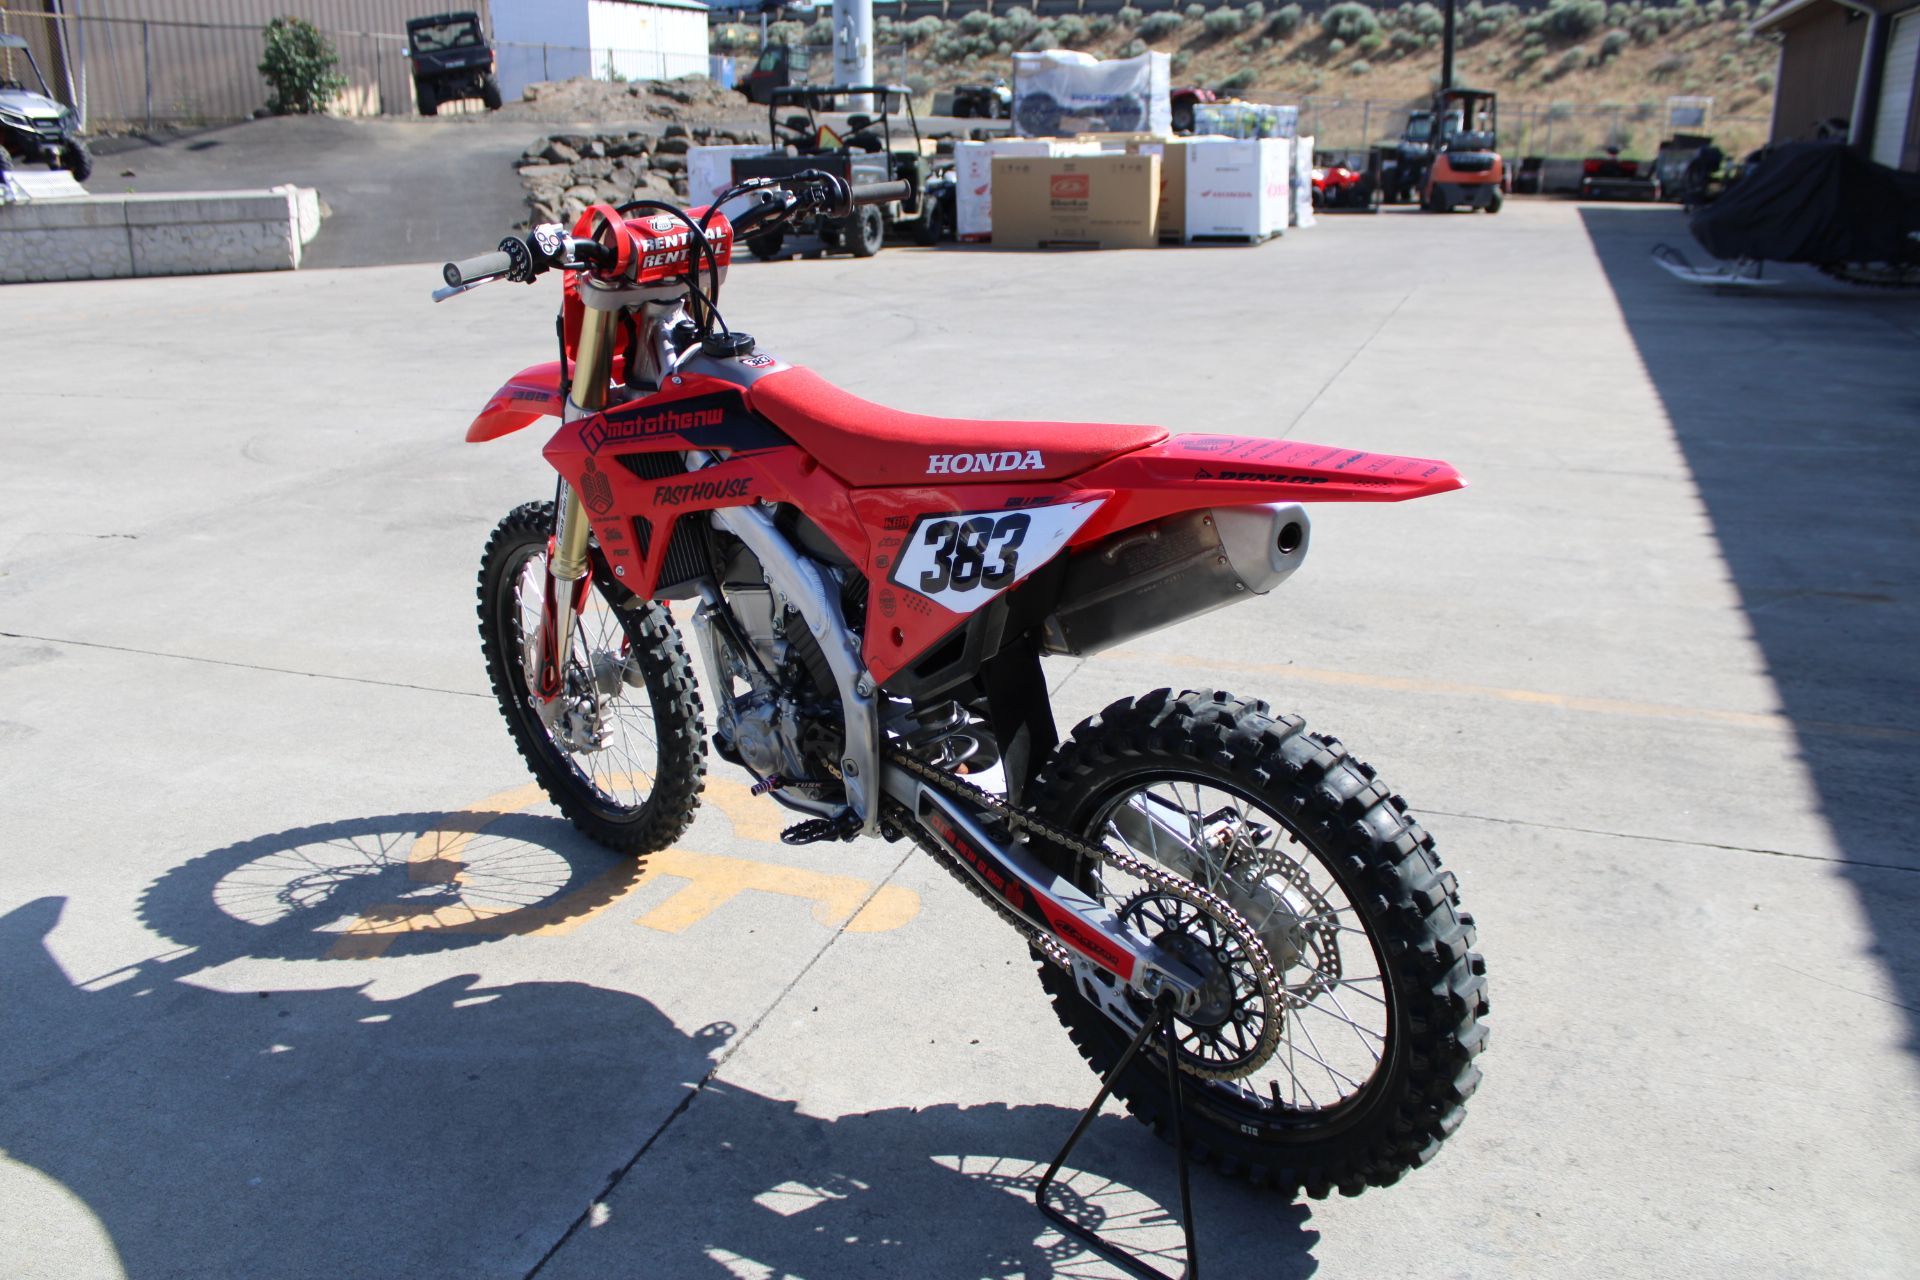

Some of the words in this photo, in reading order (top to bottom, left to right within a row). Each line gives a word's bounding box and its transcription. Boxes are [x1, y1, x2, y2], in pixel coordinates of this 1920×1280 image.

[642, 226, 726, 252] RENTAL
[643, 242, 726, 268] RENTAL
[926, 450, 1045, 474] HONDA
[653, 477, 752, 506] FASTHOUSE
[920, 512, 1031, 594] 383
